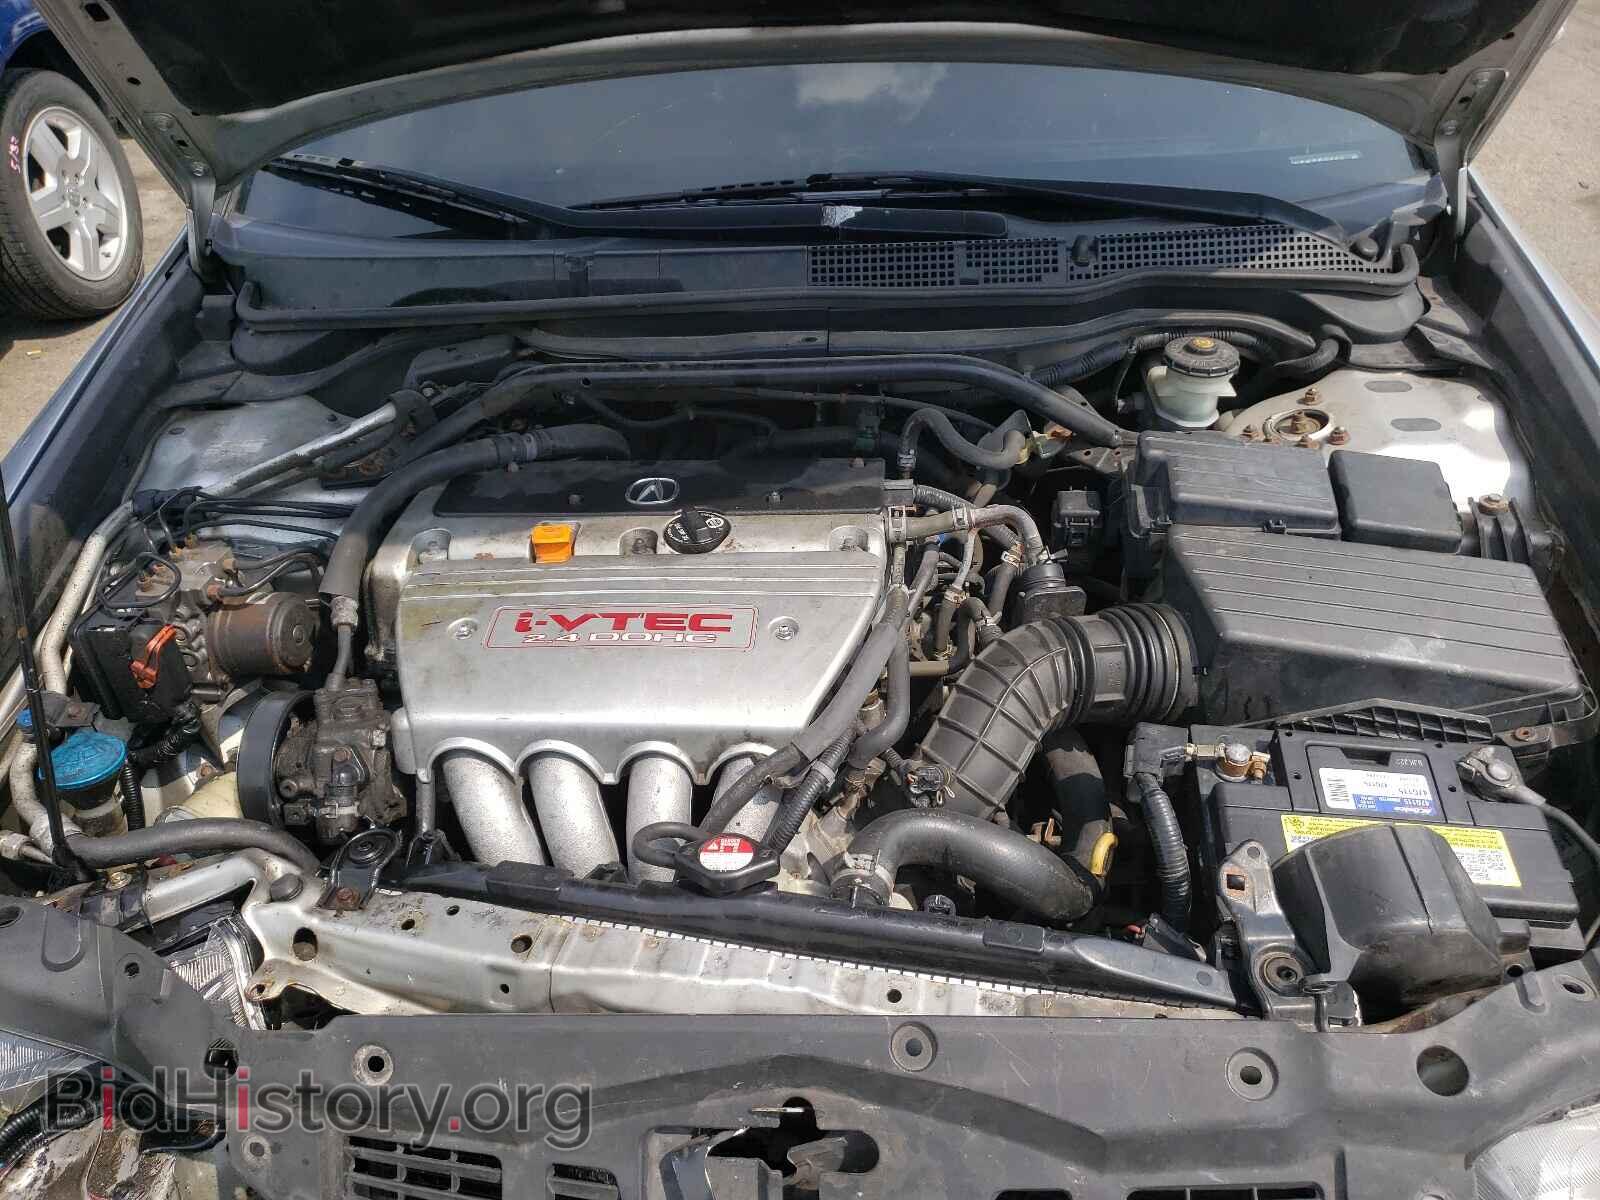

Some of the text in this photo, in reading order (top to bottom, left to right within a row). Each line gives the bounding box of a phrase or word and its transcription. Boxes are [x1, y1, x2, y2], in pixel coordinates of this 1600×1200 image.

[514, 612, 733, 632] i-VTEC
[522, 633, 717, 645] 2.4 DOHC
